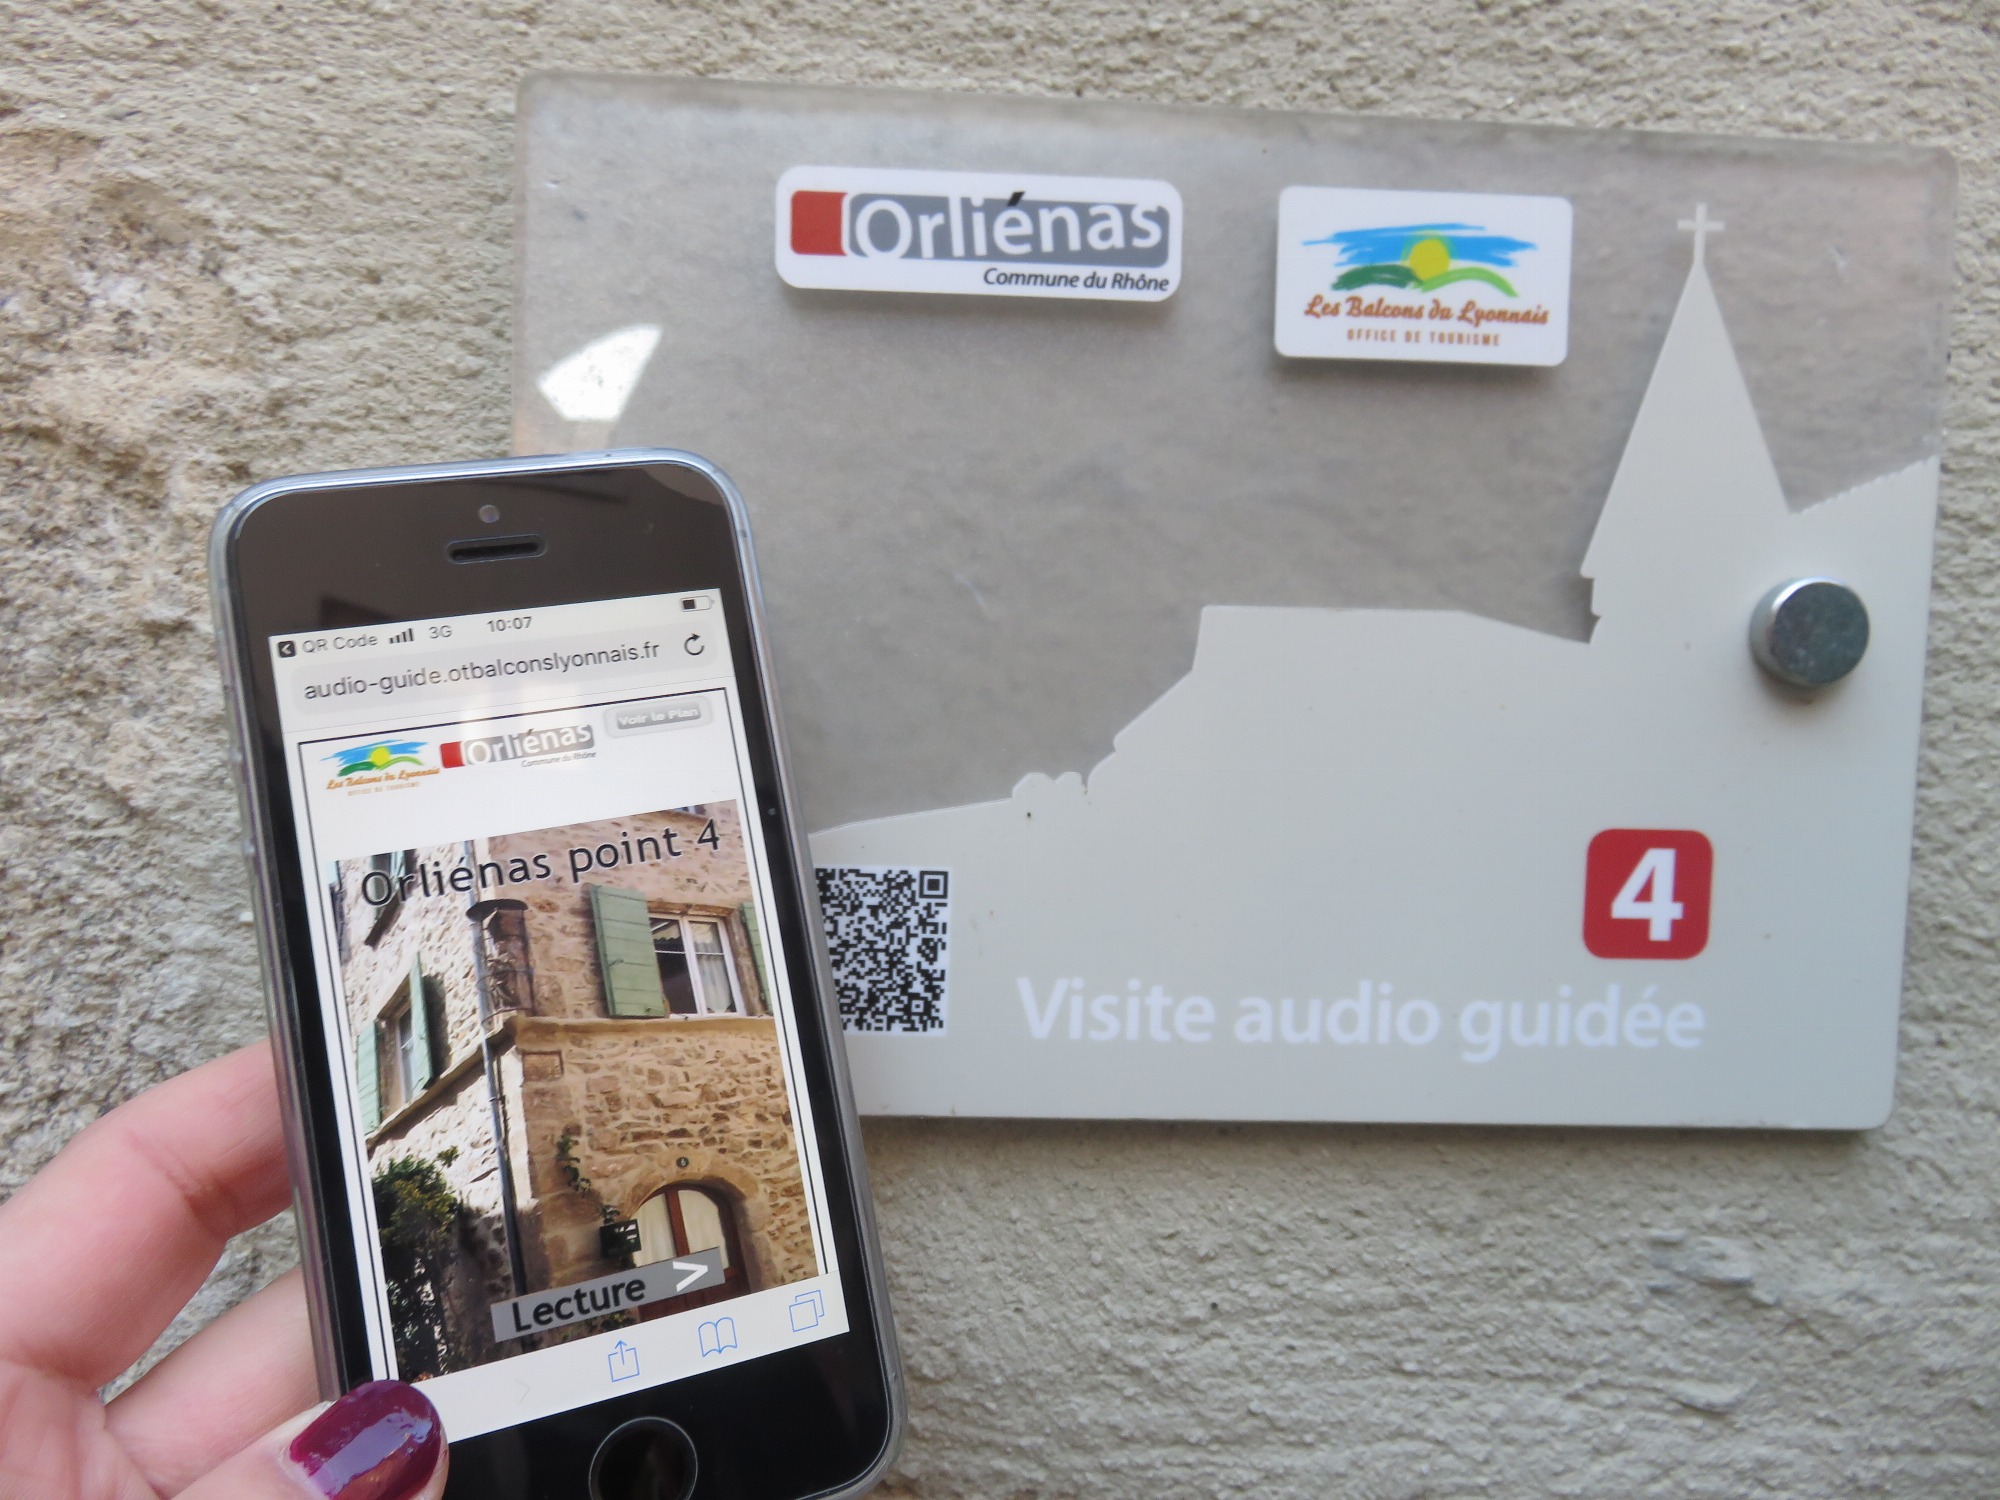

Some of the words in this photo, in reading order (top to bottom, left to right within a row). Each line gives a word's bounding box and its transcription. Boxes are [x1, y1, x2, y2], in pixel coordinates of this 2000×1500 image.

[856, 191, 1163, 259] Orliénas
[983, 267, 1080, 289] Commune
[1084, 271, 1107, 289] du
[1111, 273, 1170, 292] Rhône
[1304, 294, 1341, 318] Les
[1345, 296, 1425, 320] Balcons
[1428, 299, 1453, 320] du
[1457, 300, 1550, 328] Lyonnais
[1347, 328, 1397, 342] OFFICE
[1405, 330, 1421, 343] DE
[1430, 331, 1501, 347] TOURISME
[301, 637, 329, 653] QR
[333, 634, 378, 651] Code
[428, 625, 453, 640] 3G
[487, 616, 532, 633] 10:07
[304, 642, 660, 701] audio-guide.otbalconslyonnais.fr
[618, 714, 648, 726] Voir
[650, 711, 665, 722] le
[667, 708, 699, 720] Plan
[466, 725, 591, 765] Orliénas
[361, 852, 551, 907] Orliénas
[569, 827, 682, 884] point
[697, 818, 720, 851] 4
[1611, 847, 1684, 942] 4
[1016, 976, 1215, 1042] Visite
[1234, 980, 1440, 1046] audio
[1460, 983, 1706, 1063] guidée
[511, 1278, 646, 1333] Lecture
